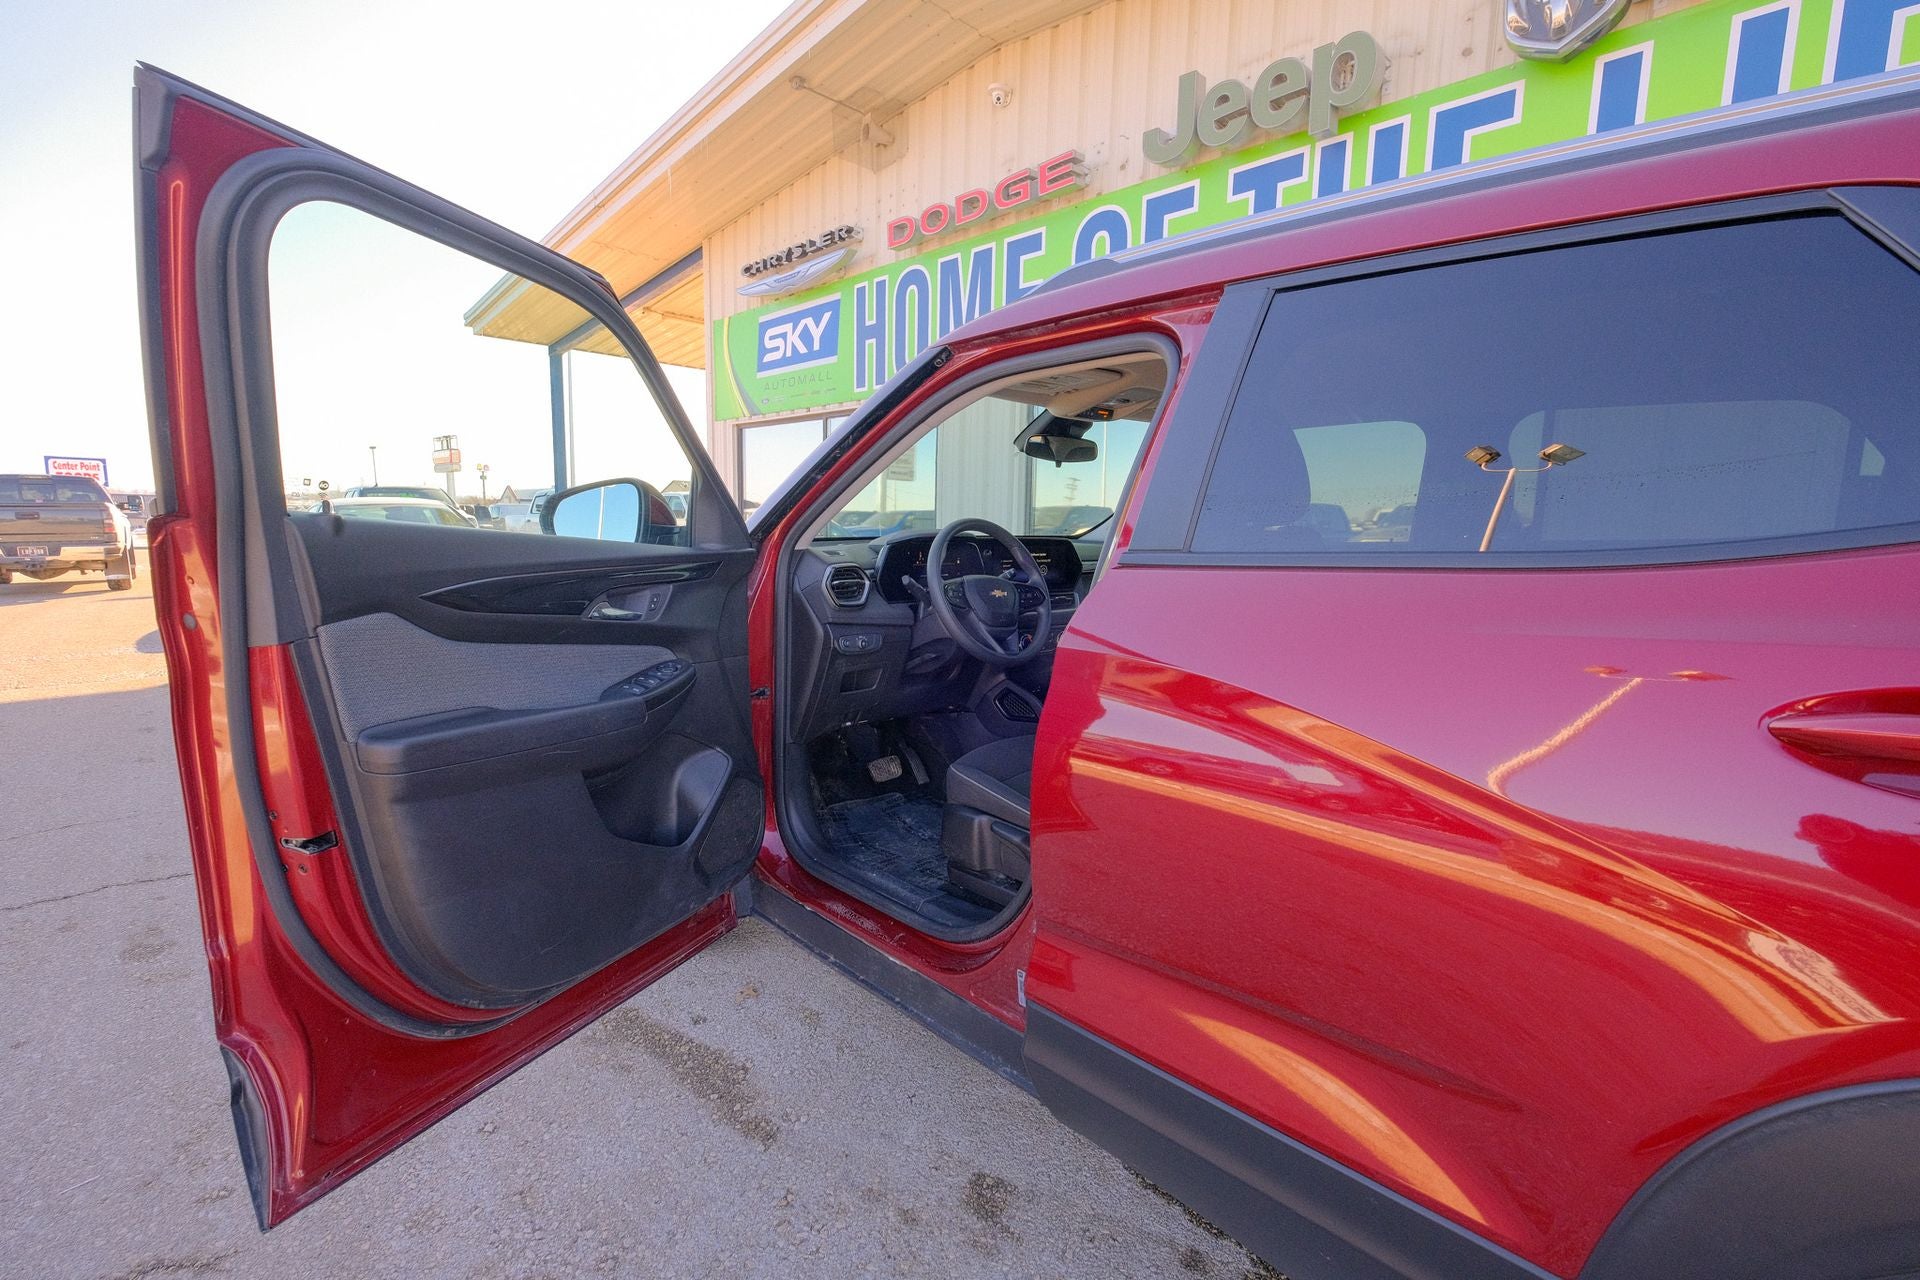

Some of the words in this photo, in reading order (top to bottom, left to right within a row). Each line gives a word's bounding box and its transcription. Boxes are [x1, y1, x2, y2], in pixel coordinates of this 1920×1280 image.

[1143, 31, 1378, 164] Jeep
[887, 150, 1080, 249] DODGE
[741, 224, 859, 278] CHRYSLER
[762, 311, 832, 363] SKY
[764, 368, 832, 391] AUTOMALL
[52, 460, 79, 471] Center
[79, 461, 101, 472] Point
